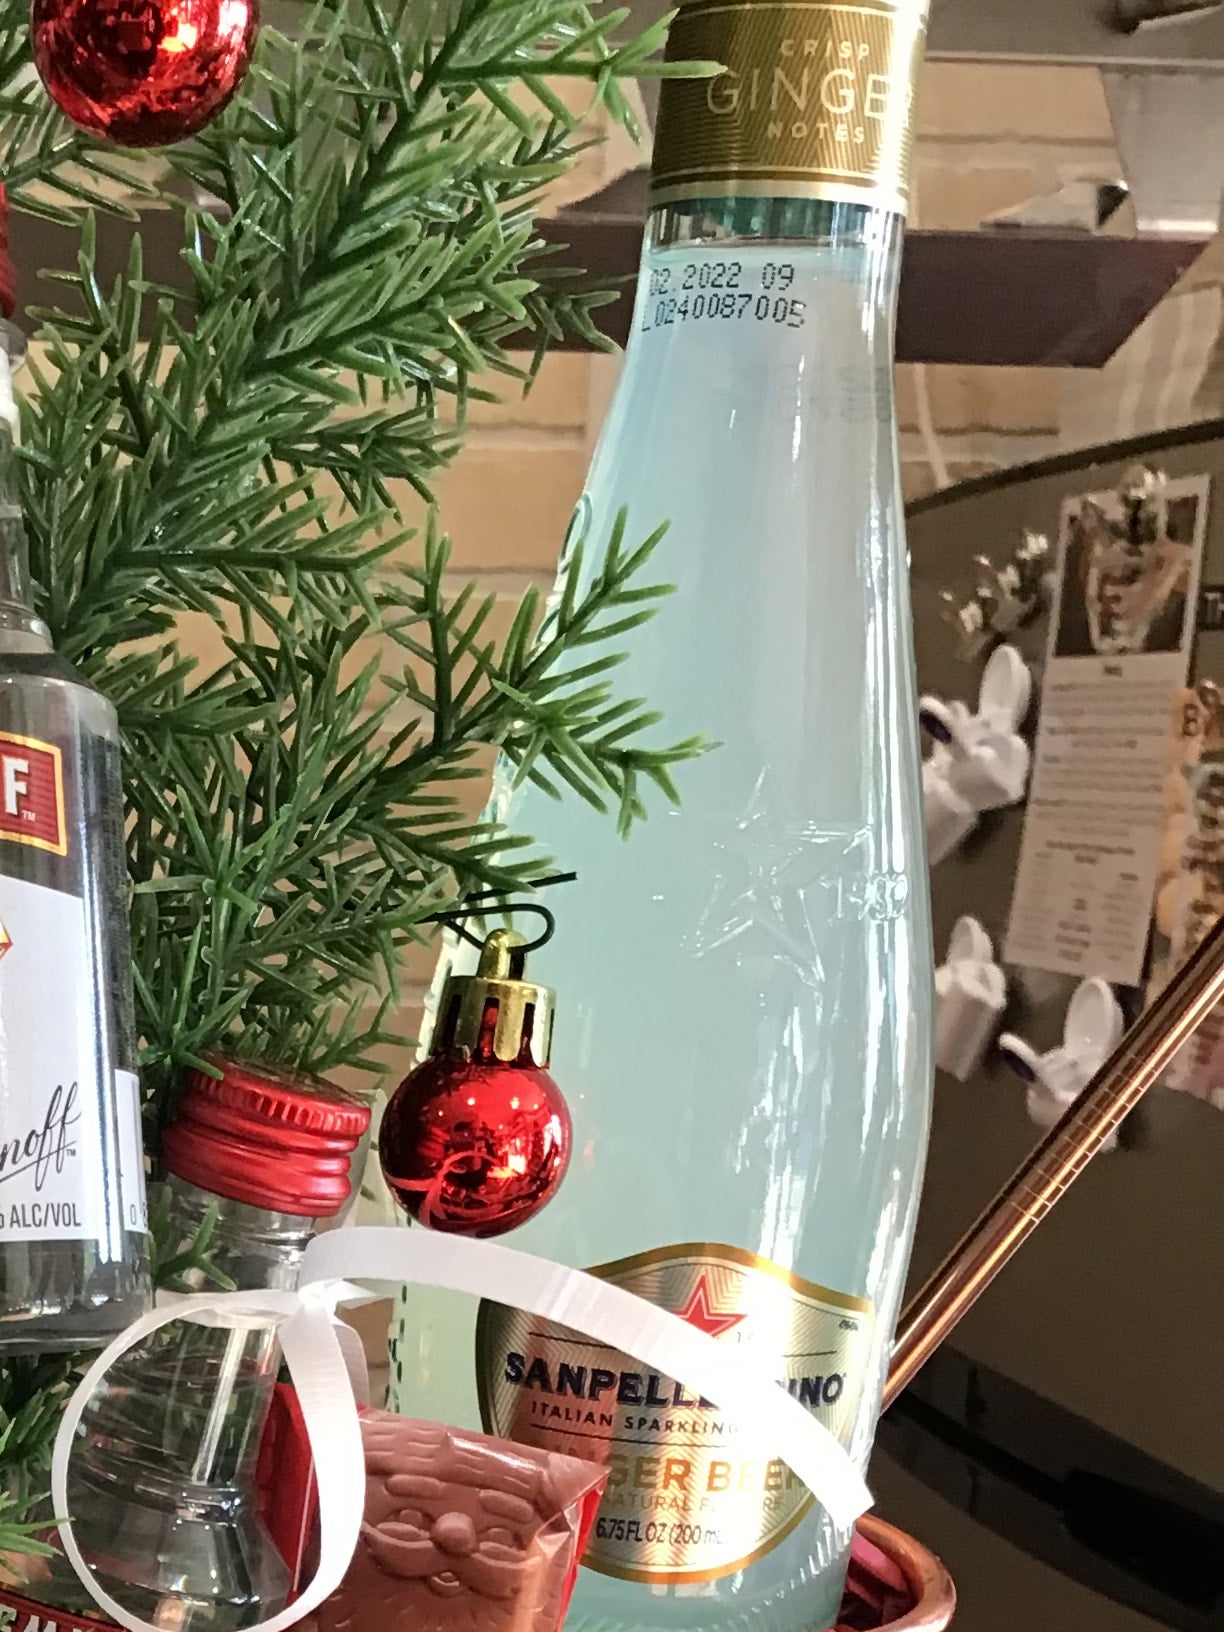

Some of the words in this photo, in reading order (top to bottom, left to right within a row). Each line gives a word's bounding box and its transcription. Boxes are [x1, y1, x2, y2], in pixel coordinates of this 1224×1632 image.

[781, 39, 870, 61] CRISP
[767, 122, 865, 144] NOTES
[761, 262, 796, 292] 09
[9, 1203, 82, 1230] ALC/VOL
[530, 1400, 614, 1428] ITALIAN
[623, 1415, 739, 1435] SPARKLING
[595, 1517, 625, 1540] 6.75
[625, 1520, 643, 1543] FL
[645, 1522, 668, 1544] OZ
[668, 1523, 702, 1546] (200
